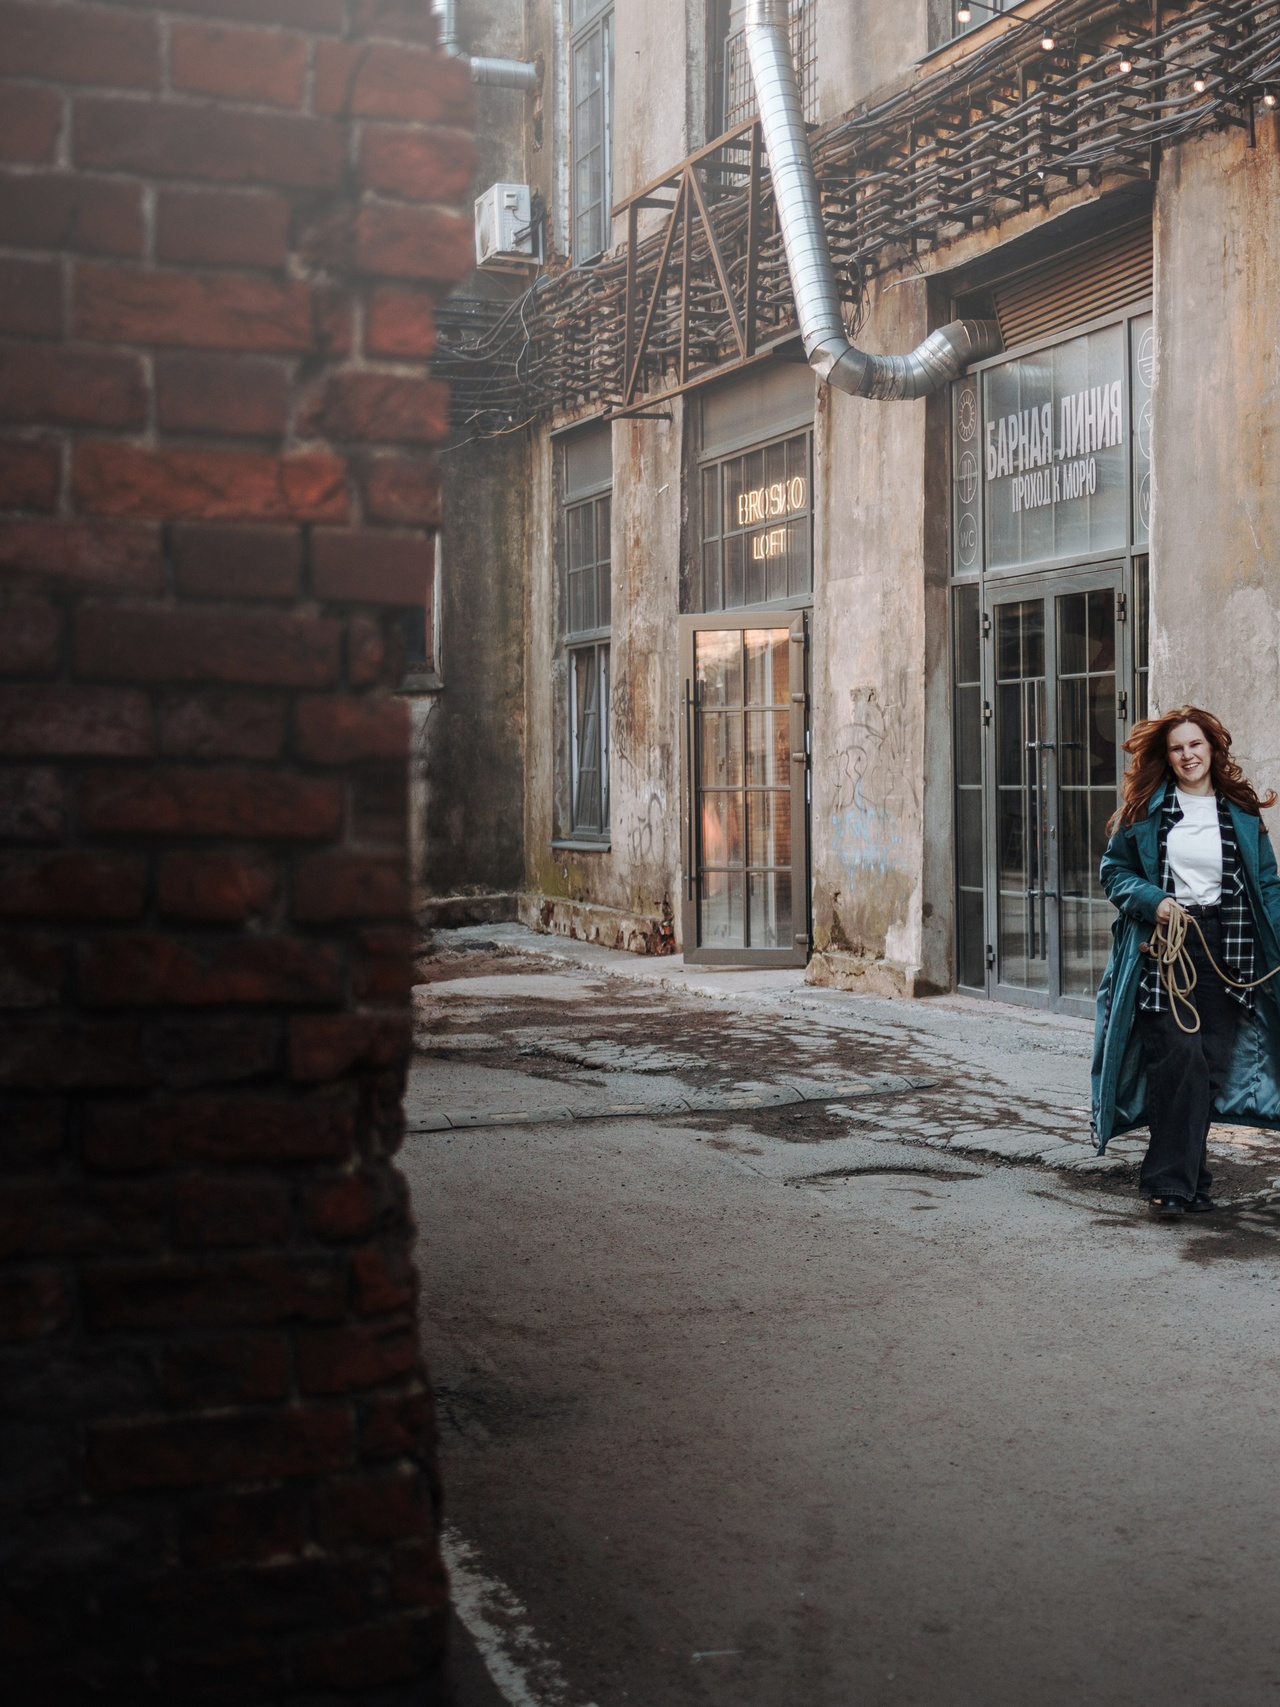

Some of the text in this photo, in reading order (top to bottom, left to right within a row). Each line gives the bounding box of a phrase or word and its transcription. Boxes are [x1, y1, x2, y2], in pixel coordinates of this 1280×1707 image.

[986, 379, 1122, 481] БАРНАЯ ЛИНИЯ
[1011, 457, 1097, 513] ПРОХОД К МОРЮ
[753, 528, 786, 560] LOFT
[960, 530, 975, 548] WC
